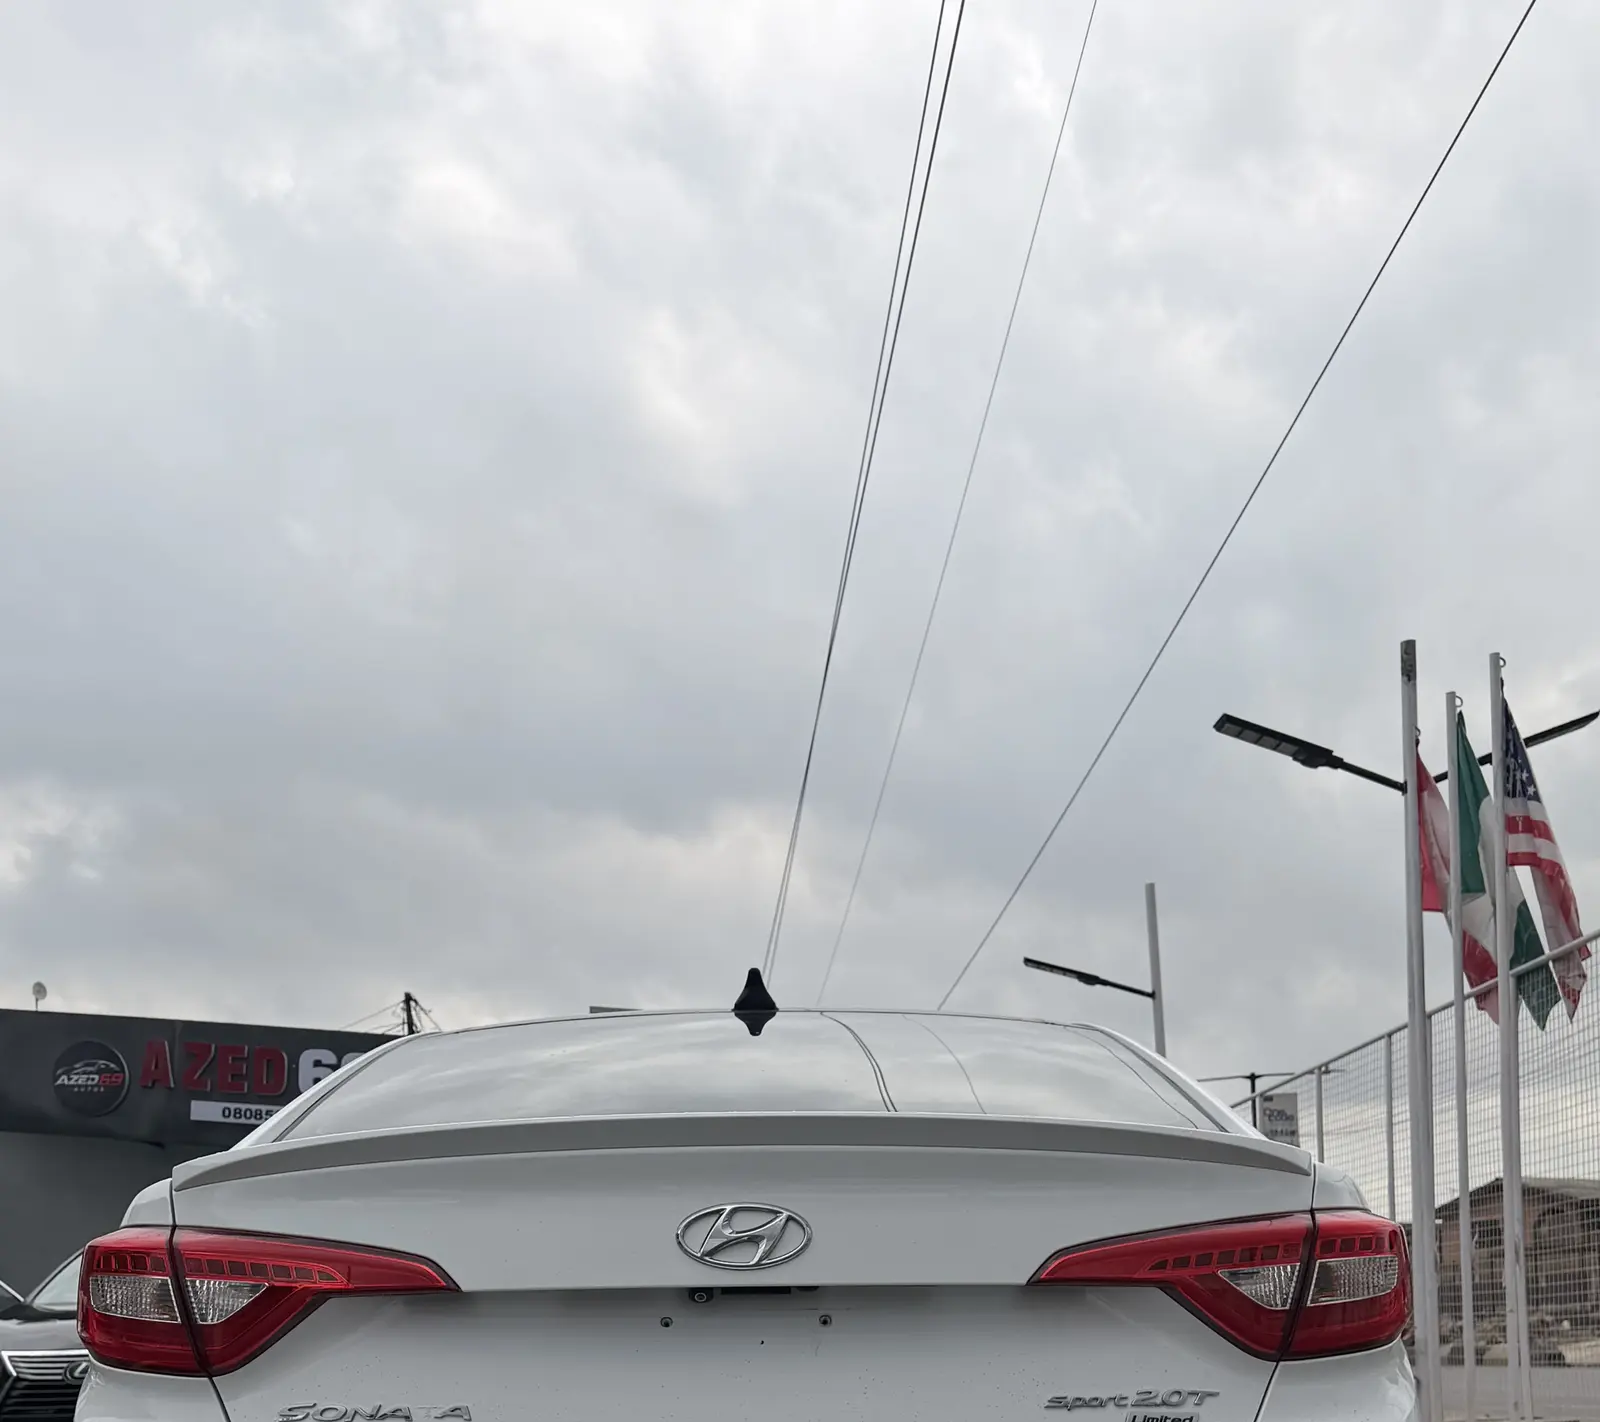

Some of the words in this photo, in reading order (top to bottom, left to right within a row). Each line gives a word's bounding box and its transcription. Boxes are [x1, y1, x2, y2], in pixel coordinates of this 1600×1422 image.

[140, 1040, 288, 1096] AZED
[54, 1073, 124, 1086] AZED69
[222, 1107, 281, 1120] 08085
[1044, 1394, 1129, 1411] Sport
